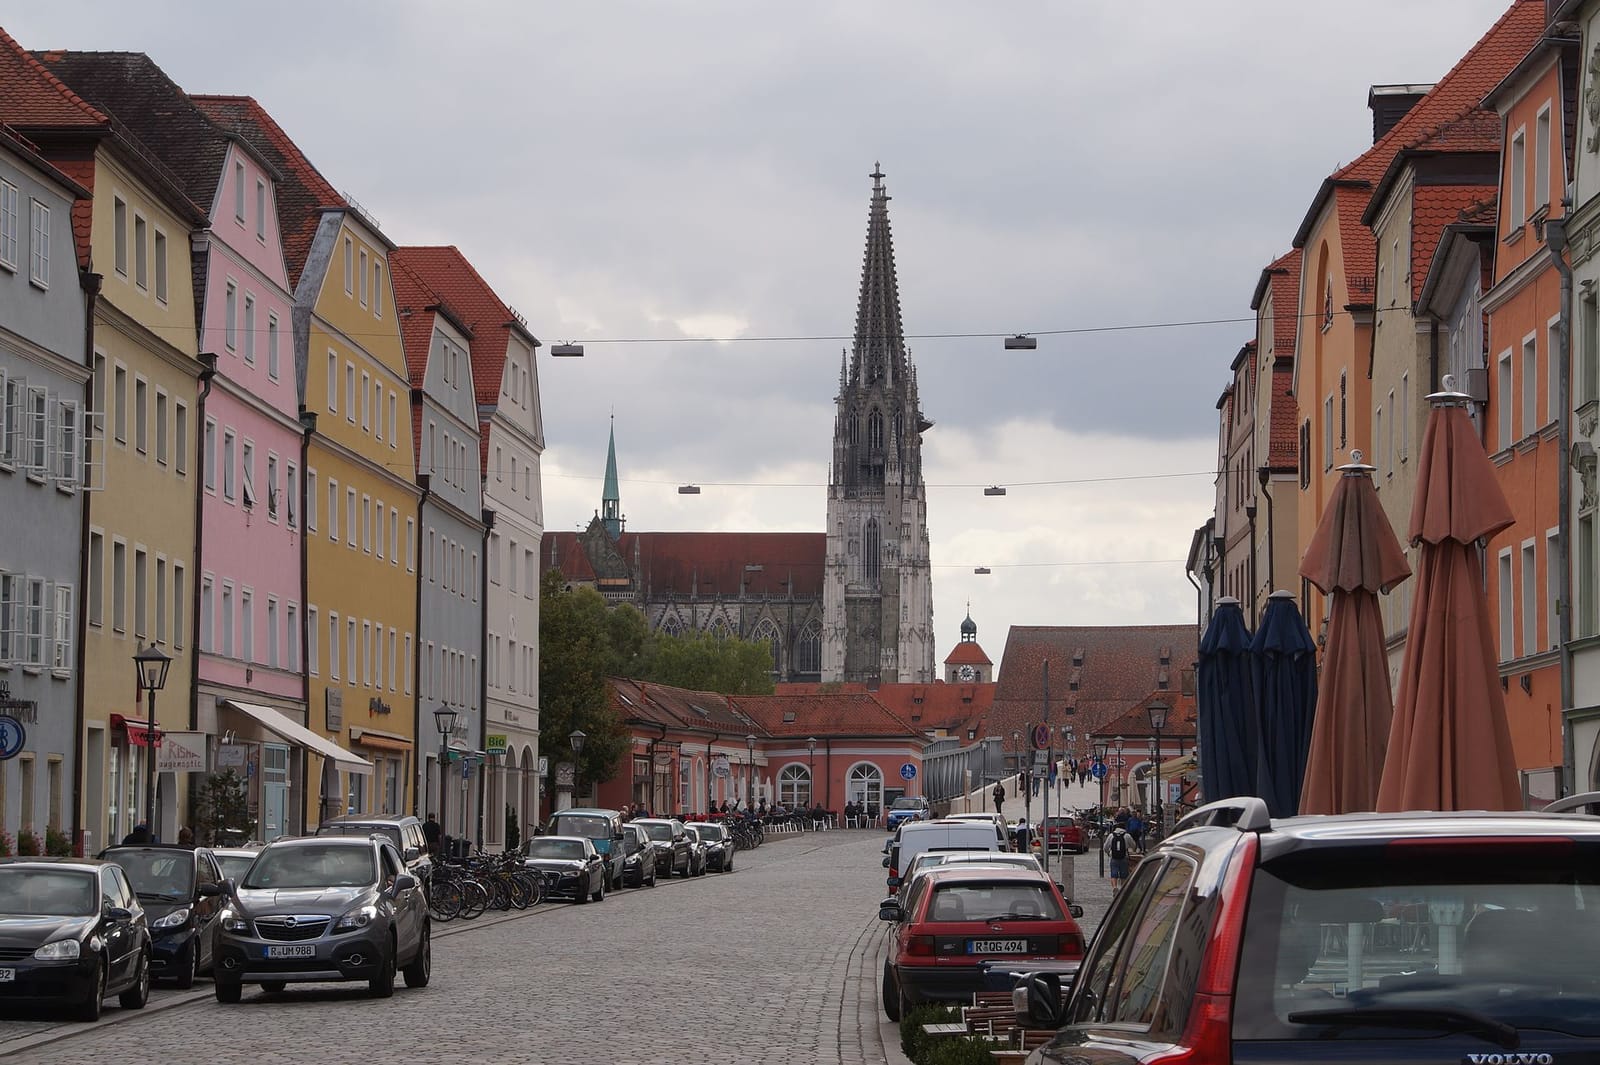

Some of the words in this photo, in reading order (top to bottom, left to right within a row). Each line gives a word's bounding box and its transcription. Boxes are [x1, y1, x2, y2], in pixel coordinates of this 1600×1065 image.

[489, 736, 505, 746] Bio
[271, 947, 277, 956] R
[282, 946, 294, 956] UM
[295, 946, 312, 955] 988
[976, 942, 983, 952] R
[1005, 941, 1023, 952] 494
[1467, 1053, 1553, 1065] VOLVO
